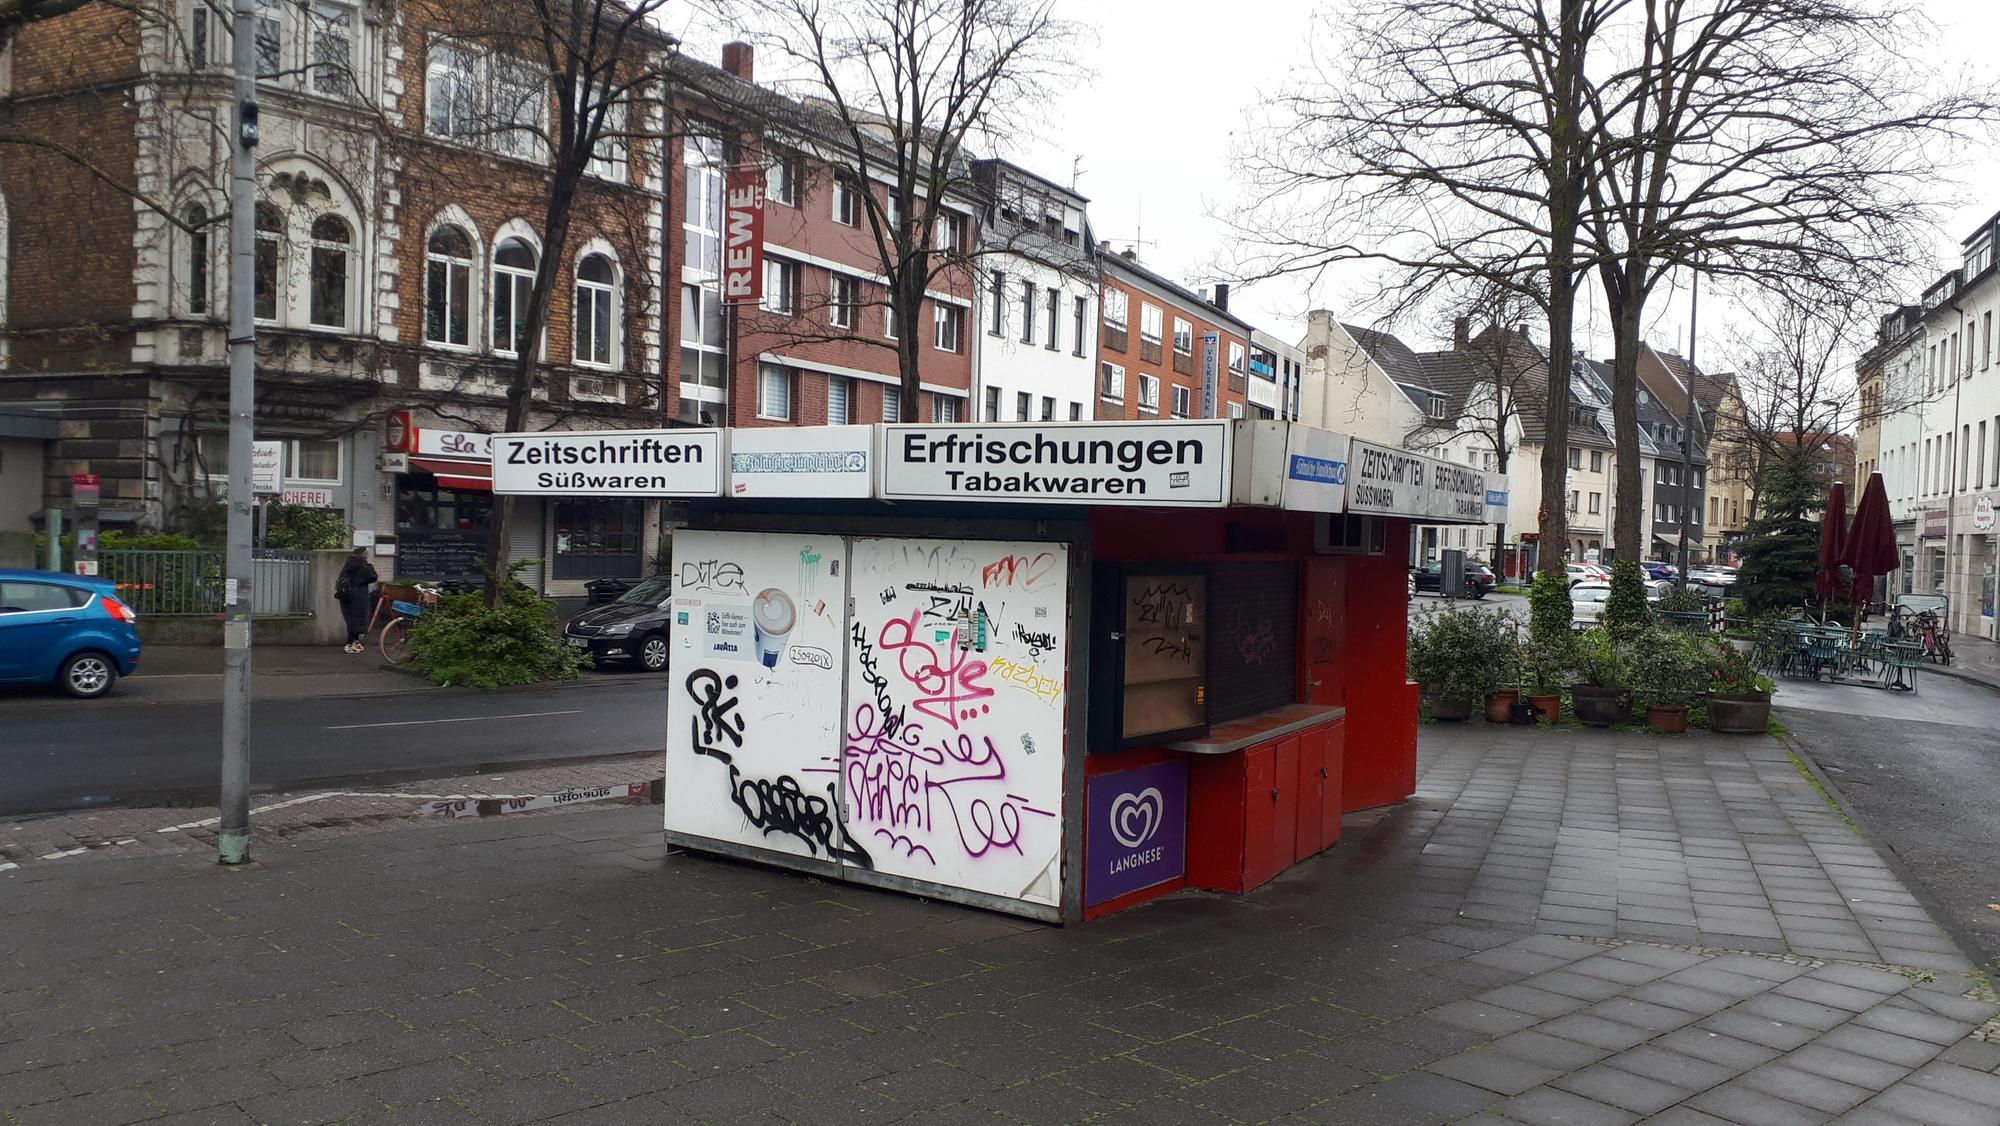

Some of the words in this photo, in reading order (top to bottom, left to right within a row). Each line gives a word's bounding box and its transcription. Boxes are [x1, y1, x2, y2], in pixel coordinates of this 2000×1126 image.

[727, 185, 754, 296] REWE
[1205, 348, 1214, 411] VOLKSBANK
[440, 433, 477, 454] La
[507, 439, 703, 465] Zeitschriften
[903, 433, 1203, 473] Erfrischungen
[537, 472, 667, 489] Süßwaren
[945, 470, 1147, 495] Tabakwaren
[713, 641, 738, 652] LAVAZZA
[1109, 848, 1162, 875] LANGNESE
